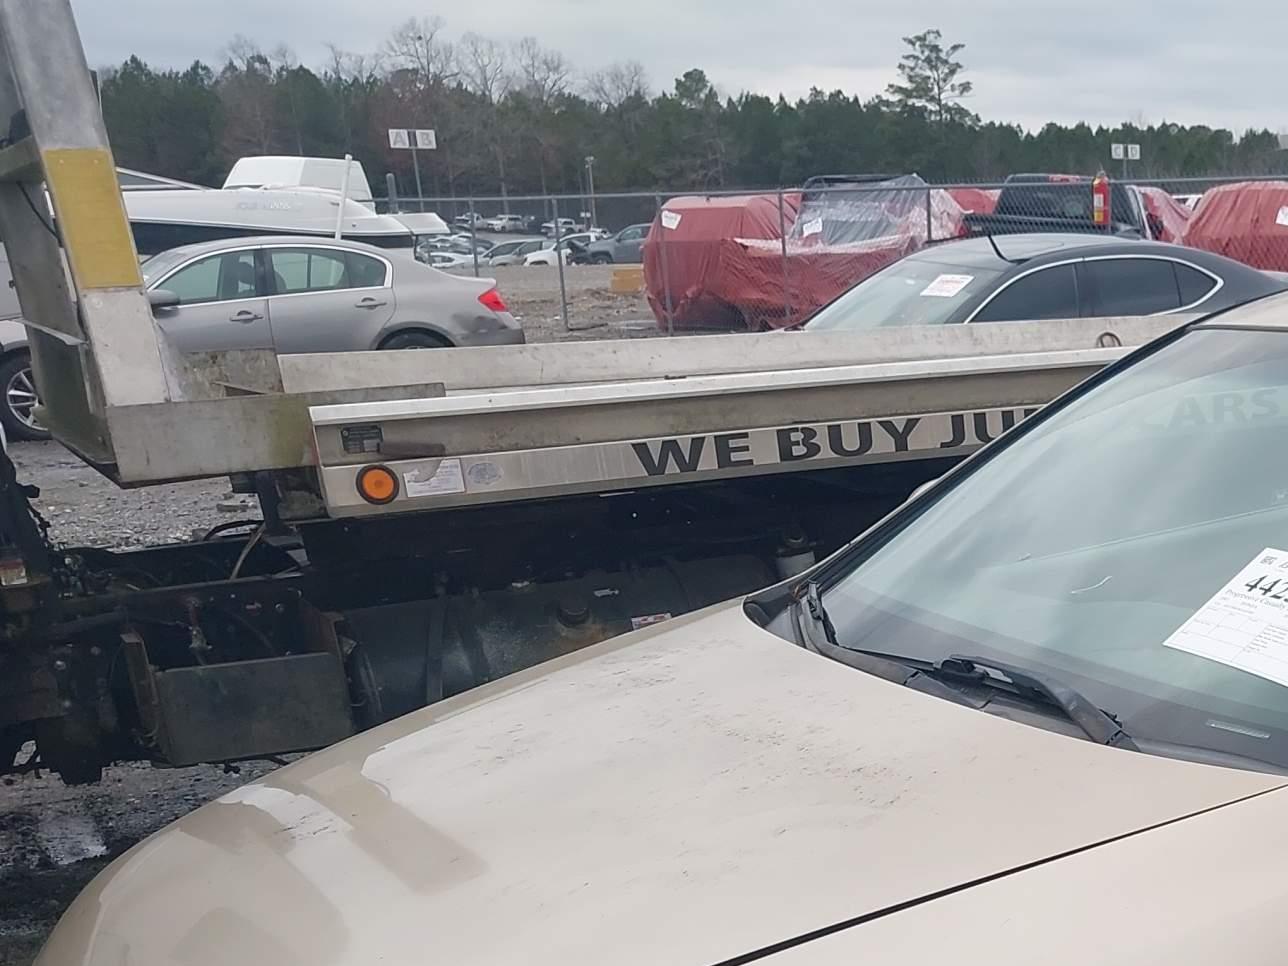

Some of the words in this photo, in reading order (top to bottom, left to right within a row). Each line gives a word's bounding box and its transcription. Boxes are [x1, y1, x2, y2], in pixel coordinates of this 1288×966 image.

[393, 130, 408, 146] A
[420, 131, 432, 146] B
[631, 432, 754, 476] WE
[776, 417, 921, 462] BUY
[940, 408, 1039, 448] JU
